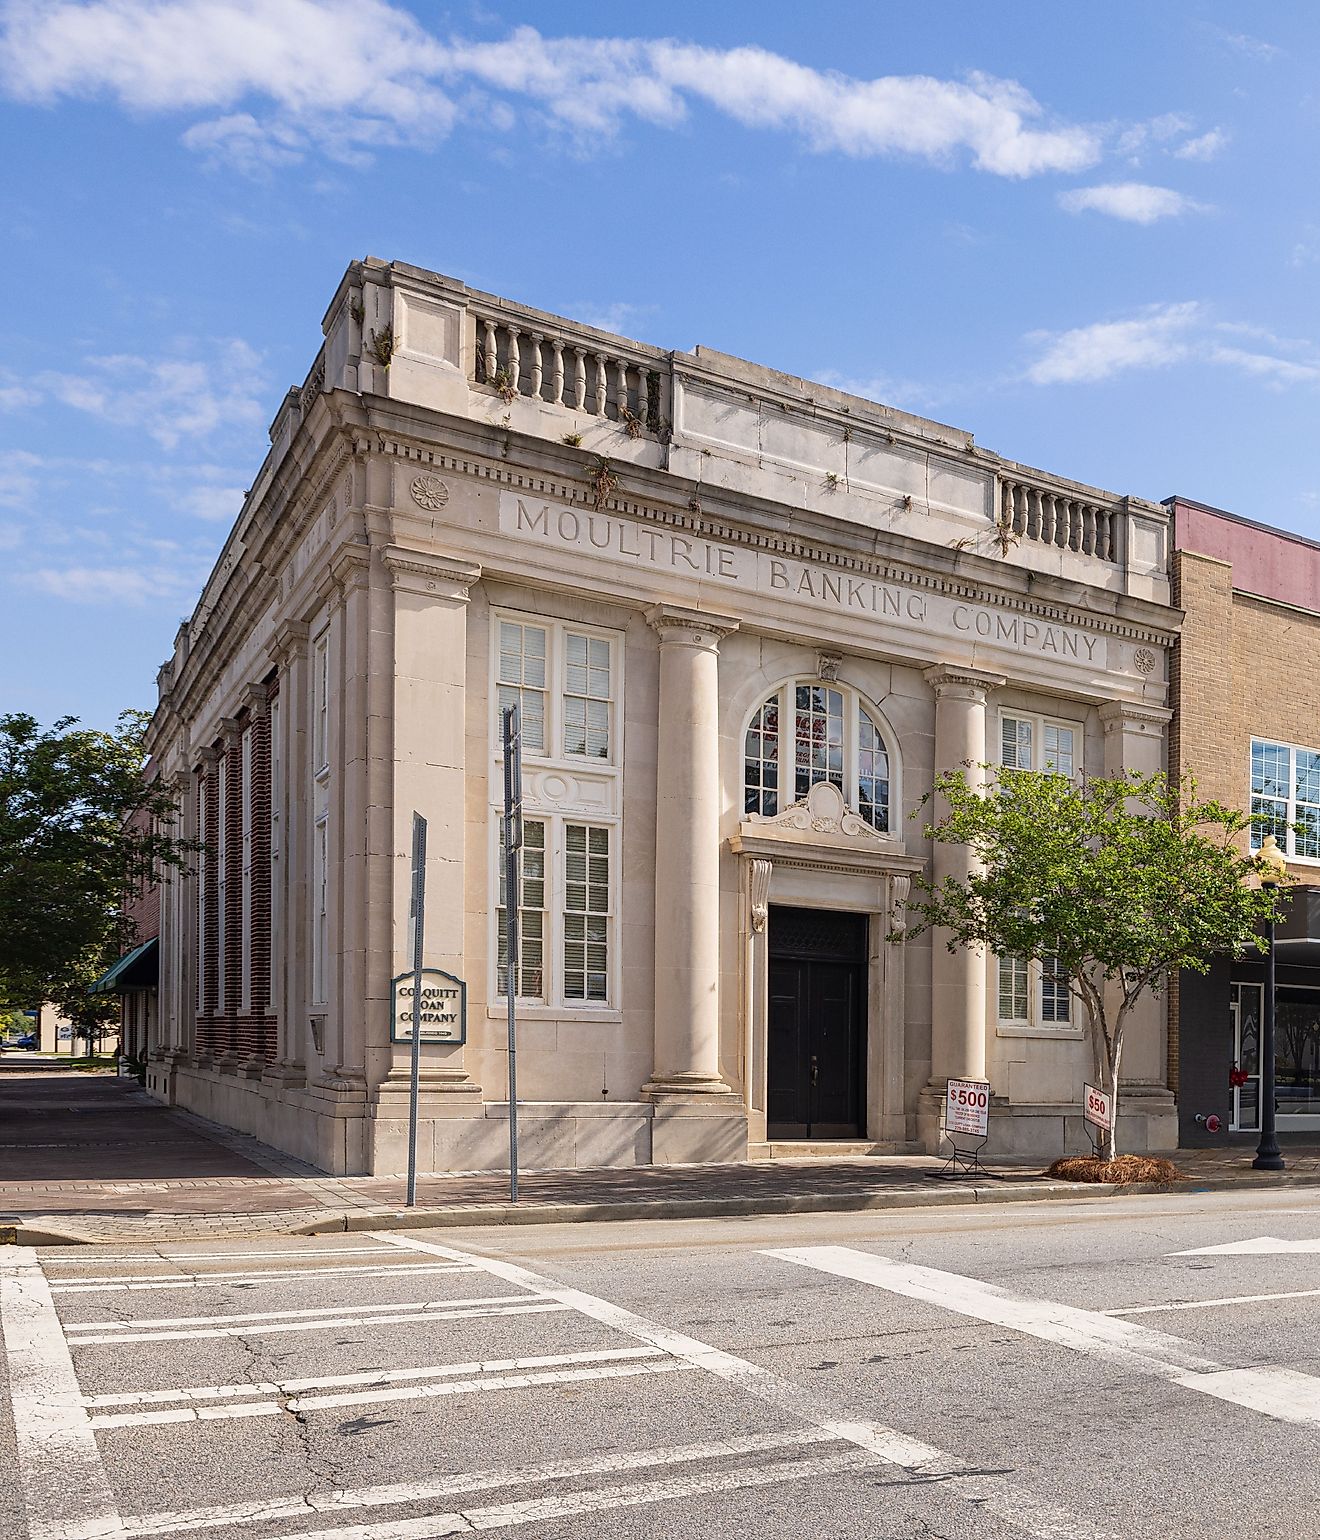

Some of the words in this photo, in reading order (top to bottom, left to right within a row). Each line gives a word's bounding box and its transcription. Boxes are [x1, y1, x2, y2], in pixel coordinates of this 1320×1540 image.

[516, 499, 738, 580] MOULTRIE
[770, 560, 928, 622] BANKING
[952, 605, 1098, 661] COMPANY
[399, 987, 459, 999] COQUITT
[420, 1000, 445, 1010] OAN
[950, 1081, 988, 1091] GUARANTEED
[950, 1089, 987, 1108] $500
[1088, 1095, 1106, 1115] $50
